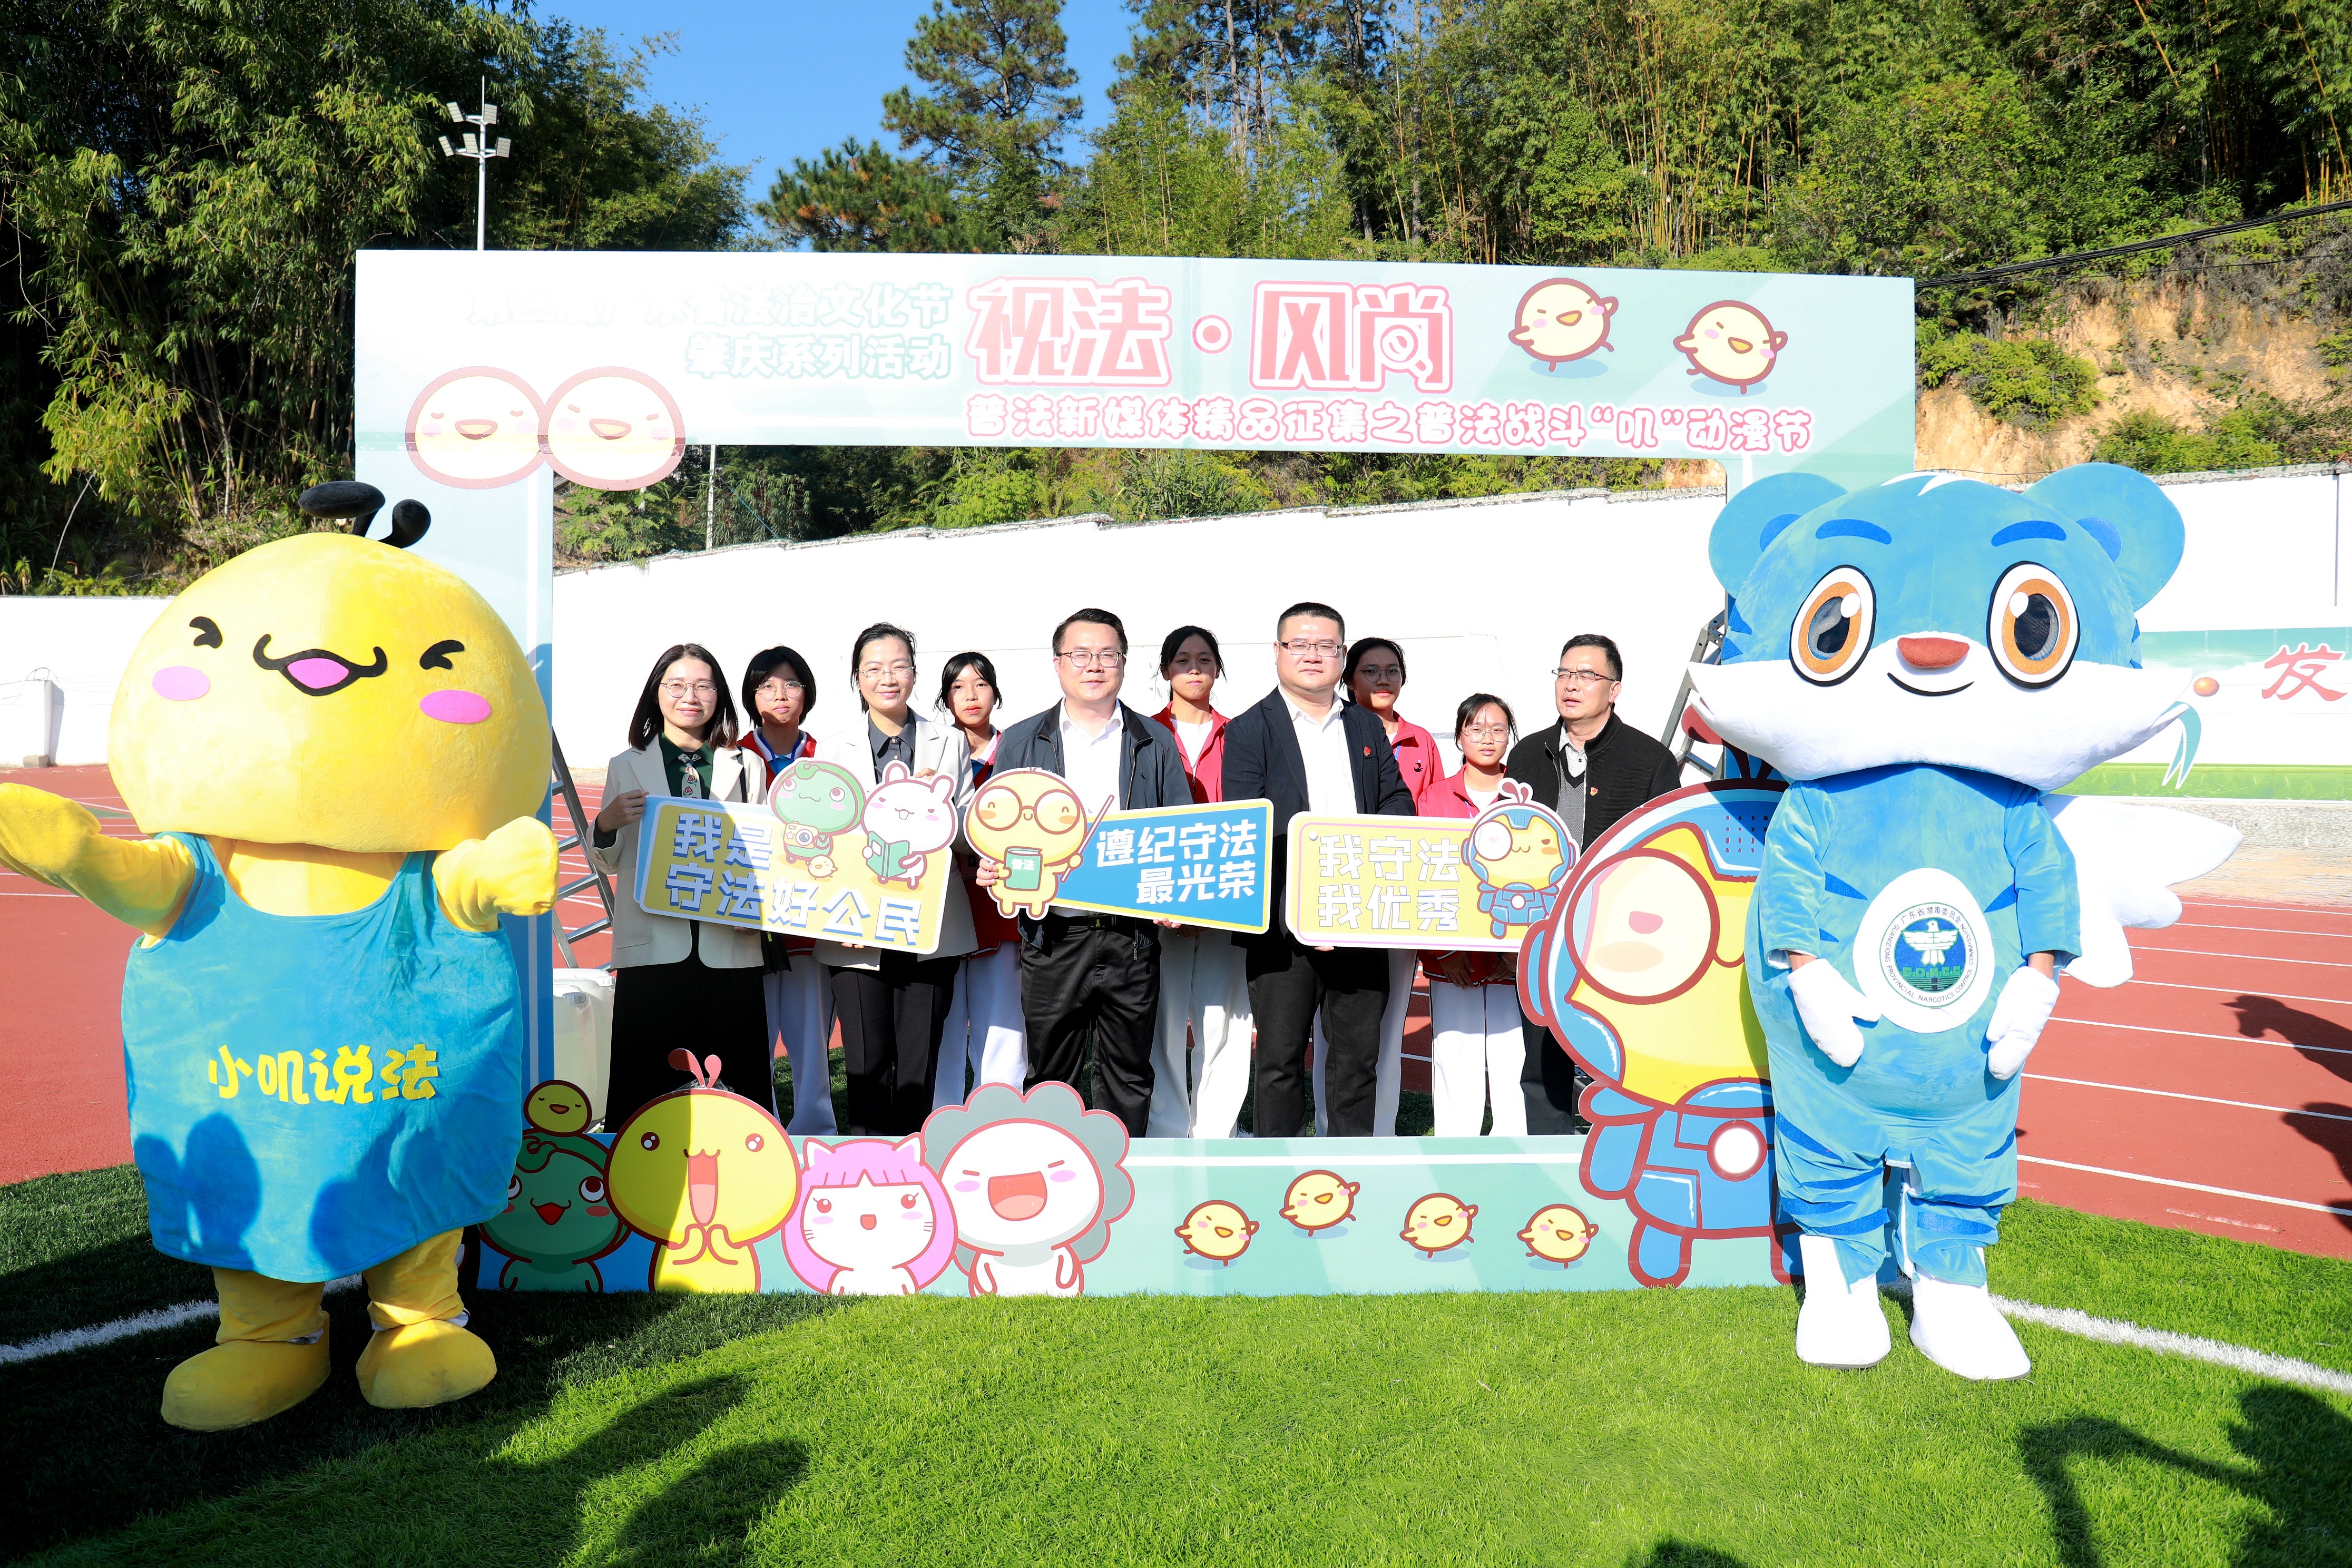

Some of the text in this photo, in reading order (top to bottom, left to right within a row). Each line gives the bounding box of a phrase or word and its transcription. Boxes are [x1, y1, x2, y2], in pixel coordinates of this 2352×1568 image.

[685, 331, 953, 379] 肇庆系列活动
[2261, 643, 2348, 701] 发
[674, 813, 772, 871] 我是
[1011, 858, 1035, 870] 普法
[1096, 820, 1257, 867] 遵纪守法
[1318, 834, 1460, 881] 我守法
[666, 863, 922, 946] 守法好公民
[1137, 860, 1256, 905] 最光荣
[1318, 885, 1459, 932] 我优秀
[1900, 906, 1962, 924] 广东省禁毒委员会
[1885, 924, 1974, 1003] GUANGDONG PROVINCIAL NARCOTICS CONTROL COMMISSION
[208, 1044, 439, 1105] 小叽说法
